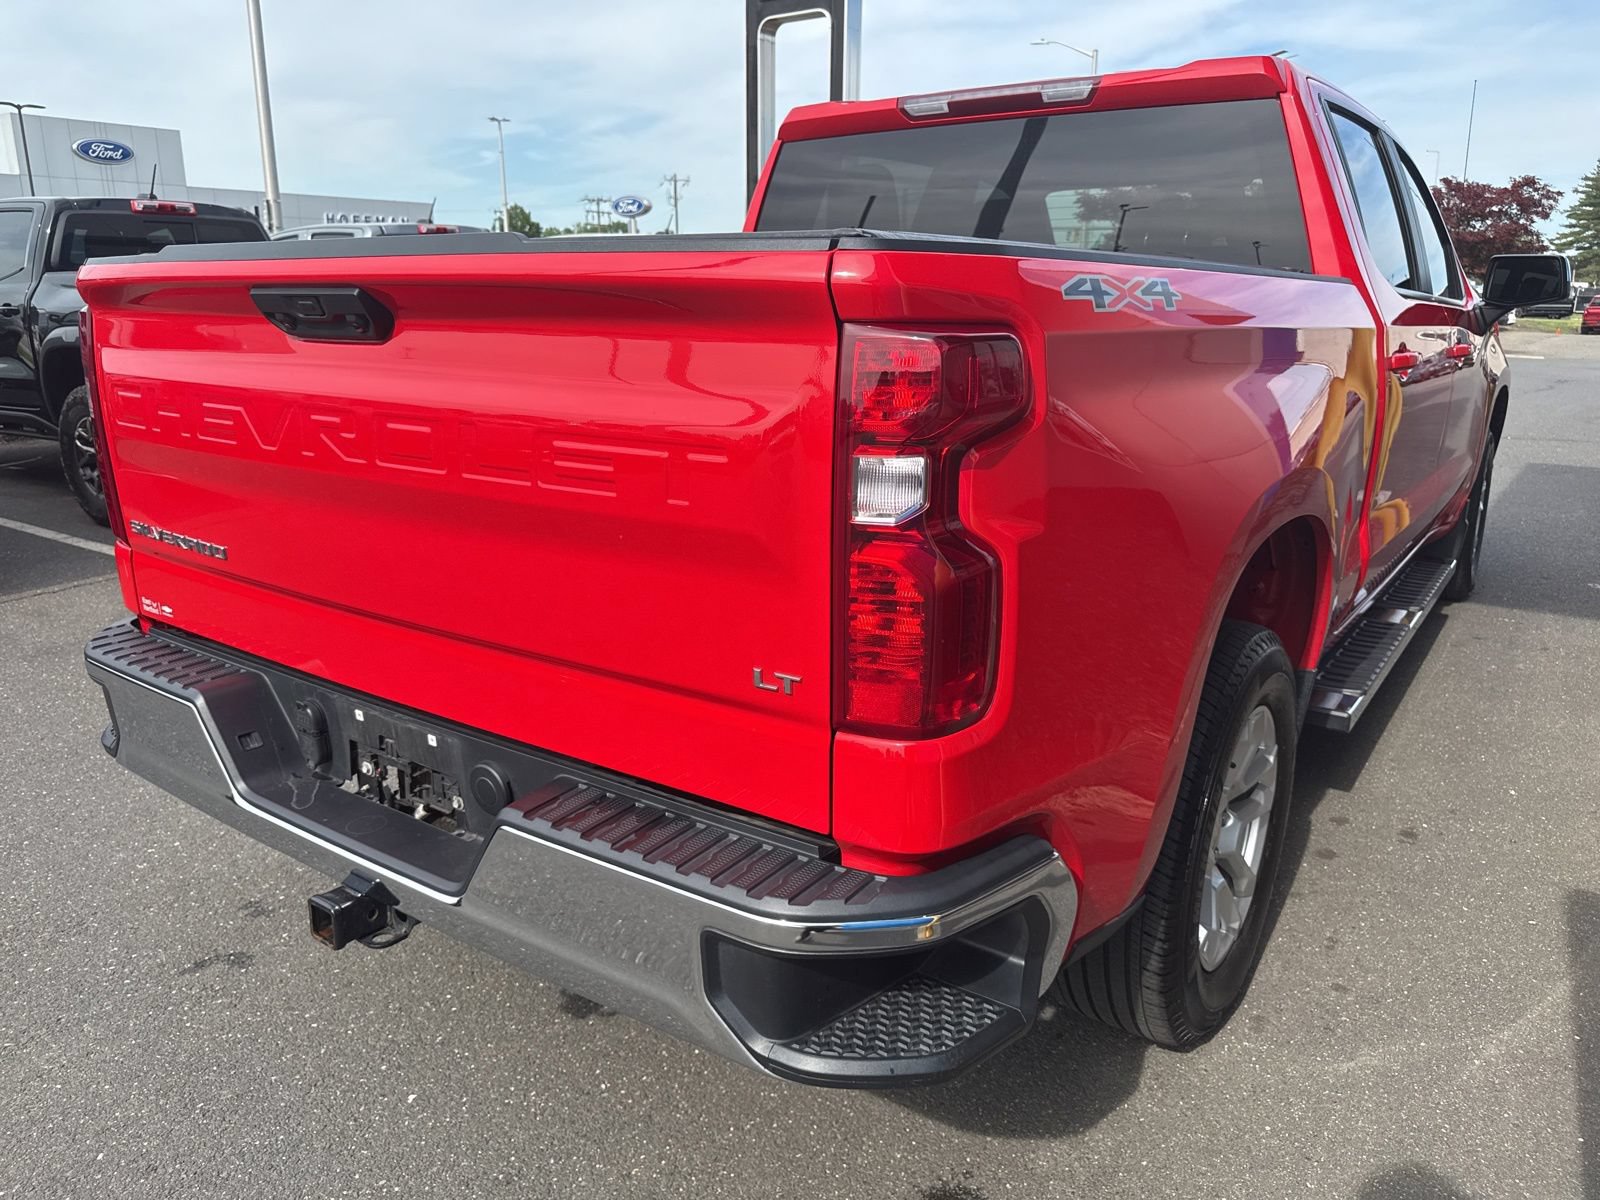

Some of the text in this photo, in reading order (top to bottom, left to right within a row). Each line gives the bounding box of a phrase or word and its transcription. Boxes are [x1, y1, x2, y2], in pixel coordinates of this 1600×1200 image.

[89, 143, 123, 159] Ford
[617, 200, 639, 212] Ford
[110, 381, 729, 506] CHEVROLET
[129, 519, 229, 561] SILVERADO
[752, 666, 802, 696] LT
